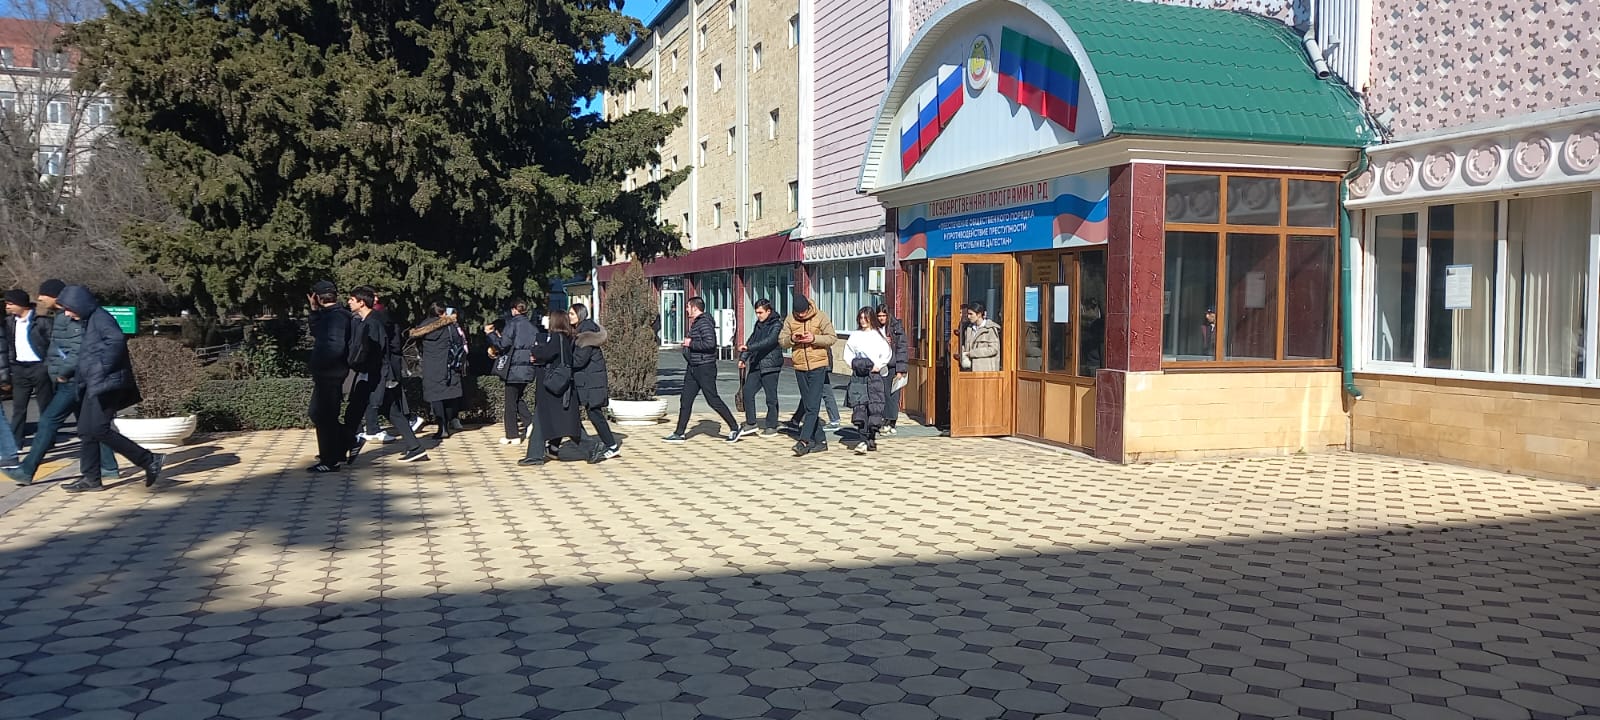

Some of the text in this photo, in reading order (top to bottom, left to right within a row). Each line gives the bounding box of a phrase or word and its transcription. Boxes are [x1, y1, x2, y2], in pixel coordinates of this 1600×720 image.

[929, 181, 1048, 217] ГОСУДАРСТВЕННАЯ ПРОГРАММА РД
[1010, 209, 1034, 221] ПОРЯДКА
[947, 227, 988, 240] ПРОТИВОДЕЙСТВИЕ
[989, 222, 1027, 236] ПРЕСТУПНОСТИ
[958, 239, 986, 249] РЕСПУБЛИКЕ
